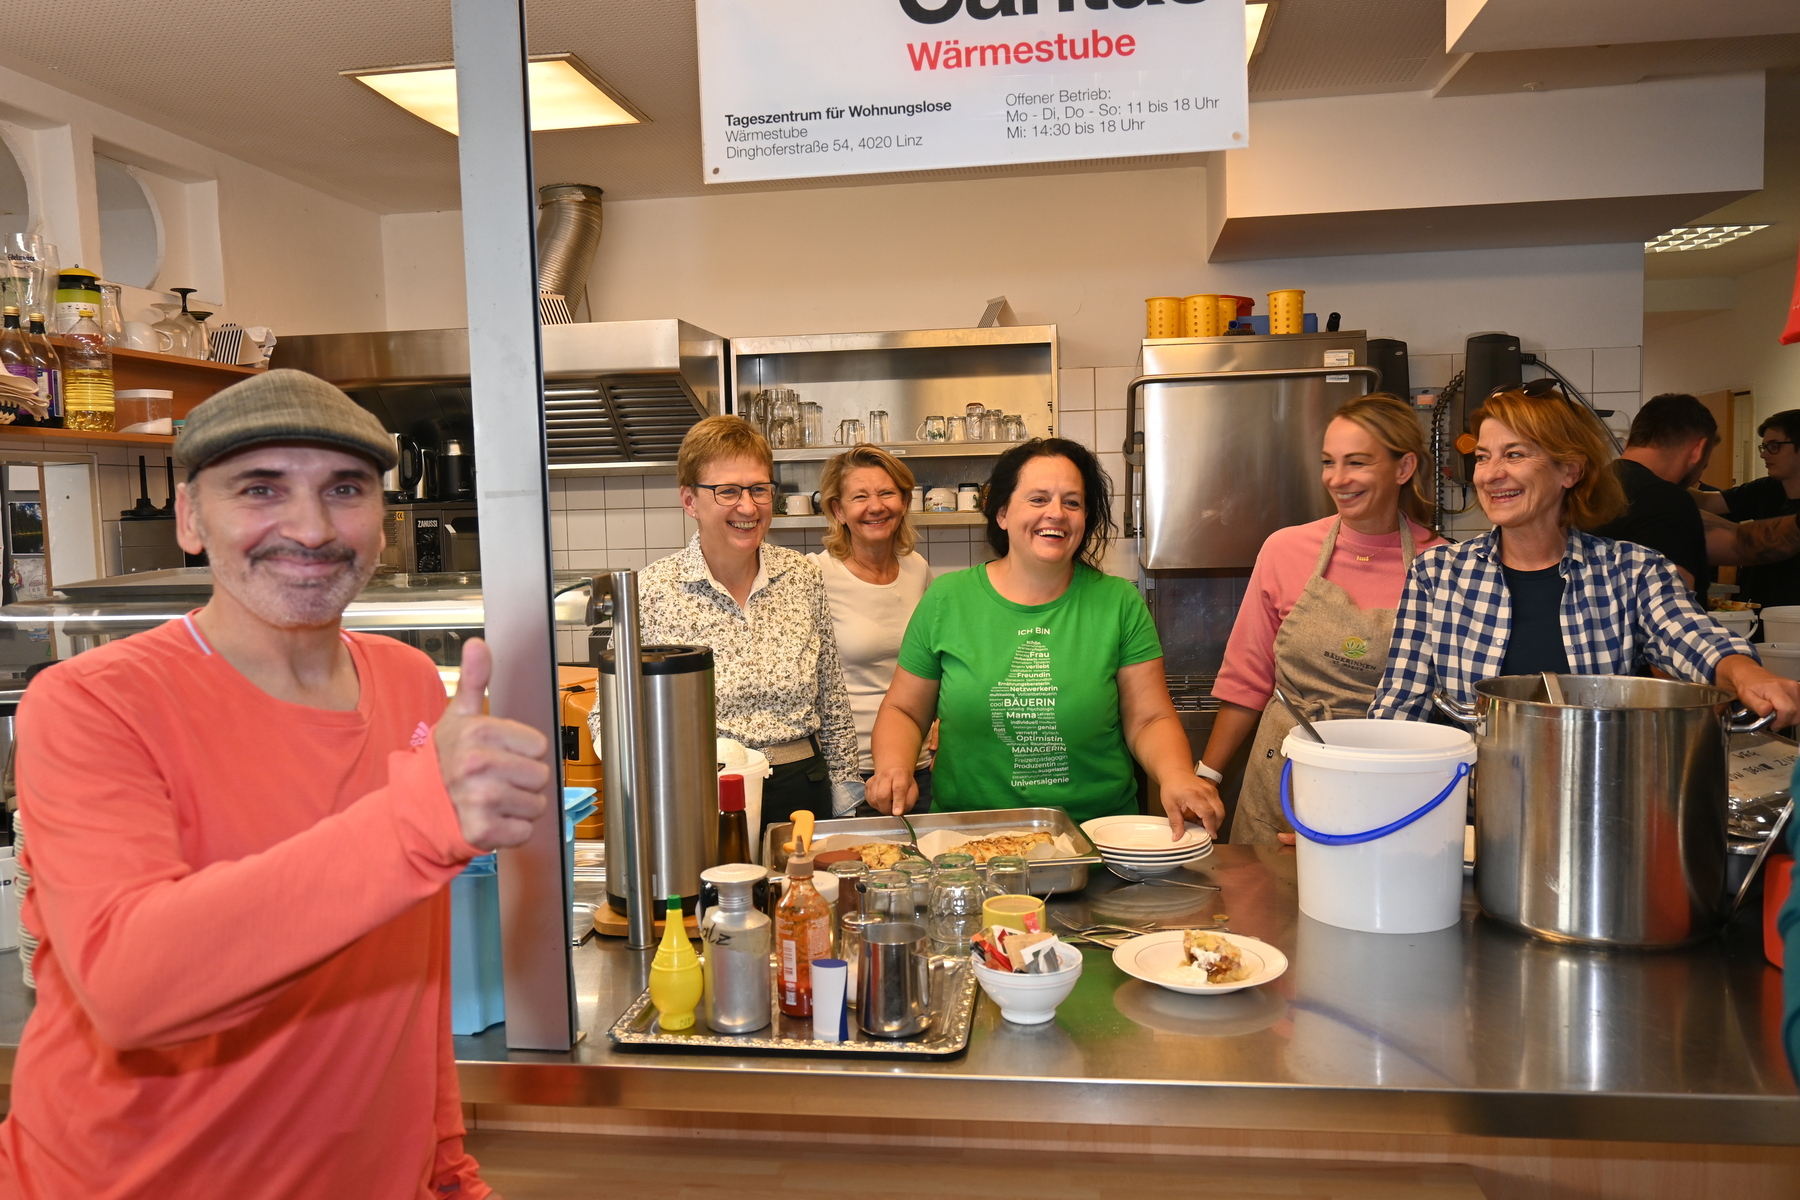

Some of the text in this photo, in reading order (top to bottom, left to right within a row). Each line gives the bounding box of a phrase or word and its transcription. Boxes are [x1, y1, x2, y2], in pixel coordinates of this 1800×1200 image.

[906, 29, 1136, 71] Wärmestube
[1005, 88, 1111, 107] Offener Betrieb:
[725, 101, 952, 128] Tageszentrum für Wohnungslose
[1006, 110, 1028, 122] Mo
[1042, 107, 1060, 121] Di,
[1065, 106, 1084, 119] Do
[1098, 104, 1121, 117] So:
[1127, 102, 1142, 114] 11
[1148, 100, 1168, 113] bis
[1174, 98, 1190, 111] 18
[1195, 96, 1219, 110] Uhr
[725, 126, 808, 143] Wärmestube
[1007, 118, 1145, 139] Mi: 14:30 bis 18 Uhr
[726, 134, 923, 160] Dinghoferstraße 54, 4020 Linz
[417, 520, 438, 528] ZANUSSI
[1018, 627, 1051, 636] ICH BIN
[1323, 650, 1377, 671] BÄUERINNEN
[1004, 697, 1056, 707] BÄUERIN
[1006, 711, 1037, 719] Mama
[1011, 776, 1070, 787] Universalgenie
